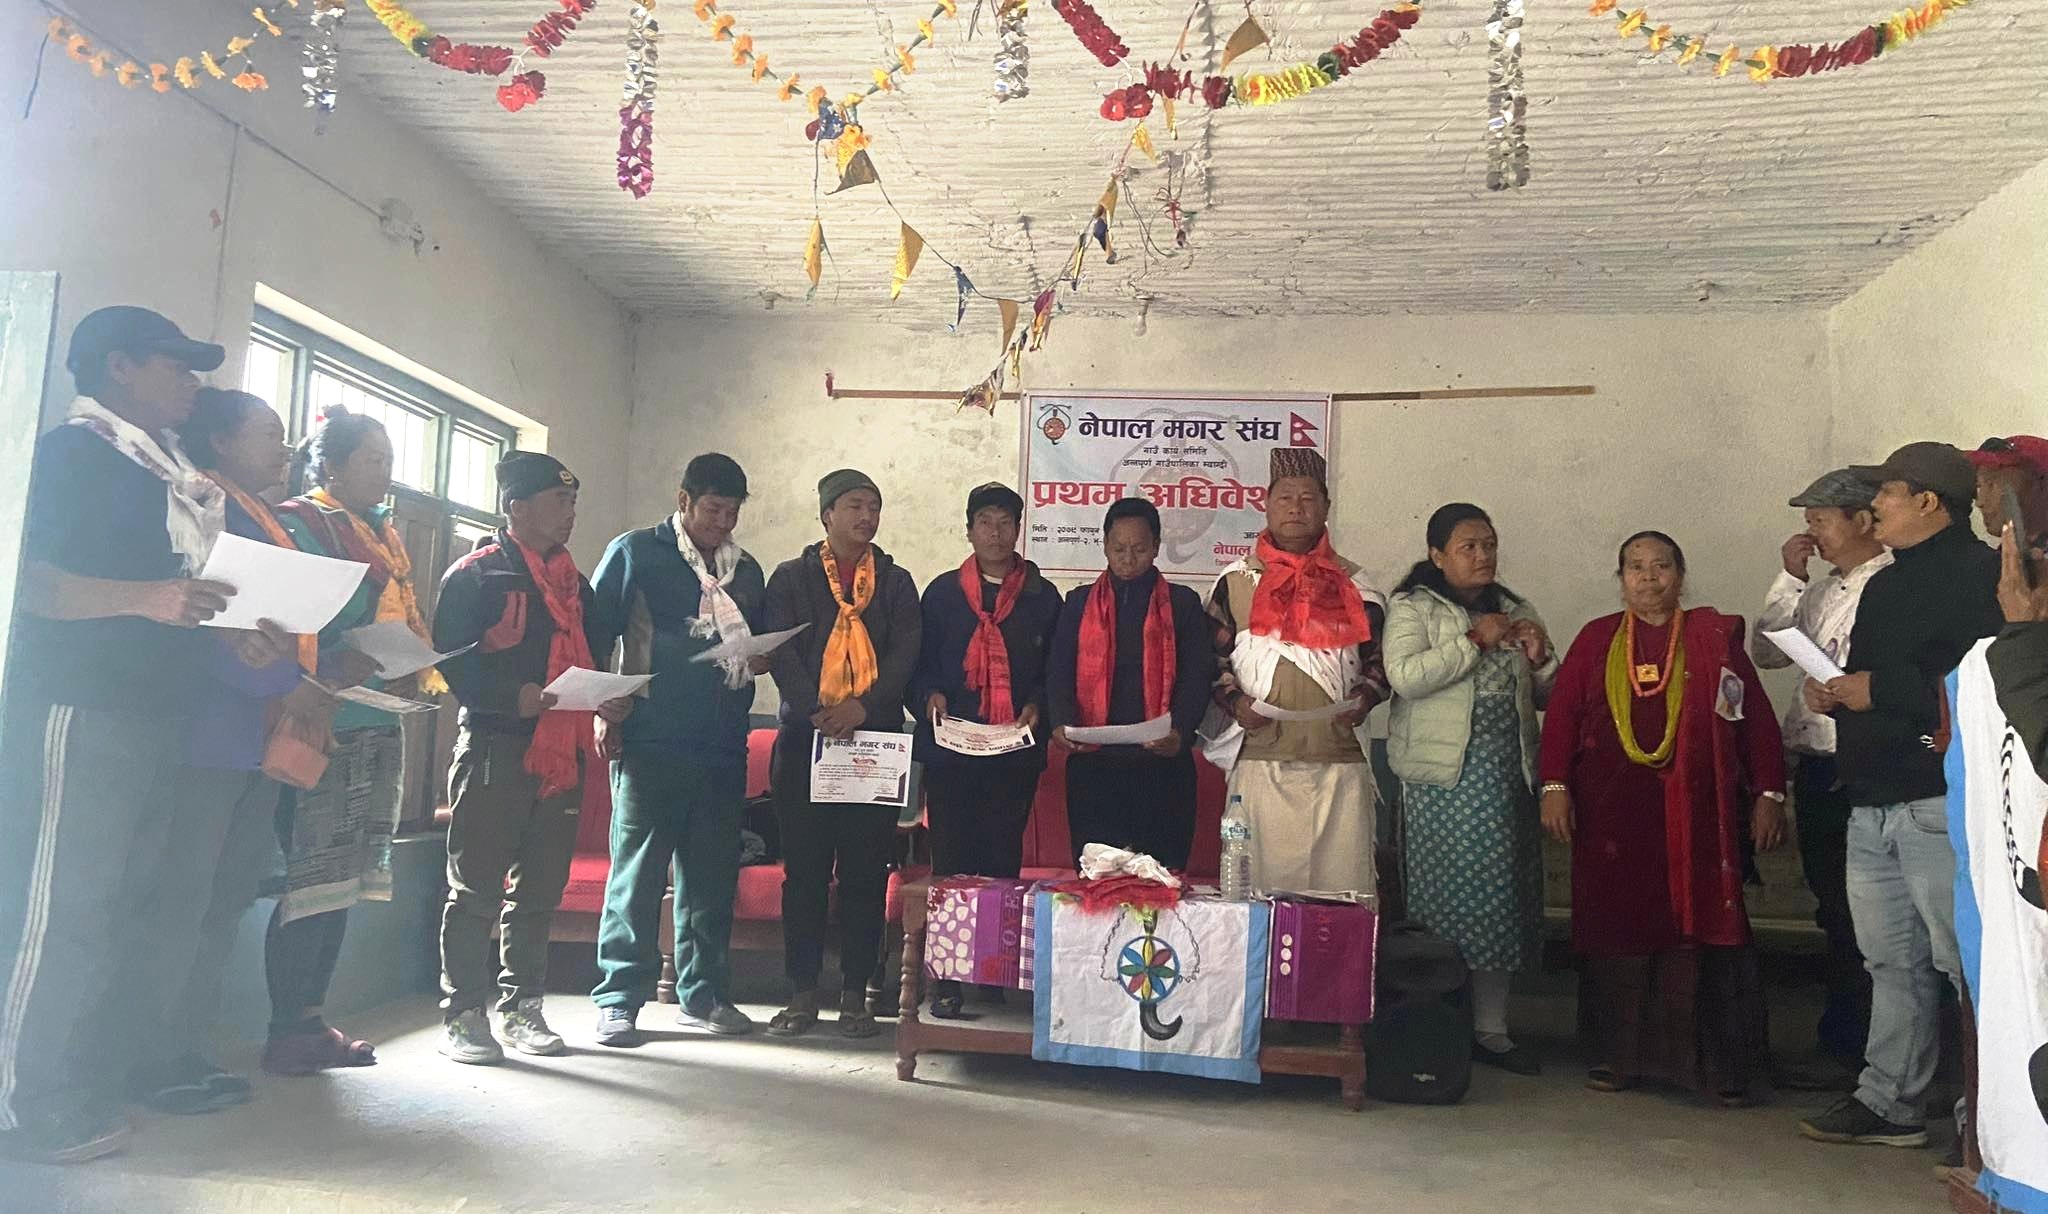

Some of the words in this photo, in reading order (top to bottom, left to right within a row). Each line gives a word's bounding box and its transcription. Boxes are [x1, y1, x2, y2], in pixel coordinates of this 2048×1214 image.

[1078, 411, 1154, 438] नेपाल
[1163, 419, 1228, 441] मगर
[1236, 417, 1282, 441] संघ
[1032, 481, 1127, 508] प्रथम
[1213, 541, 1252, 556] नेपाल
